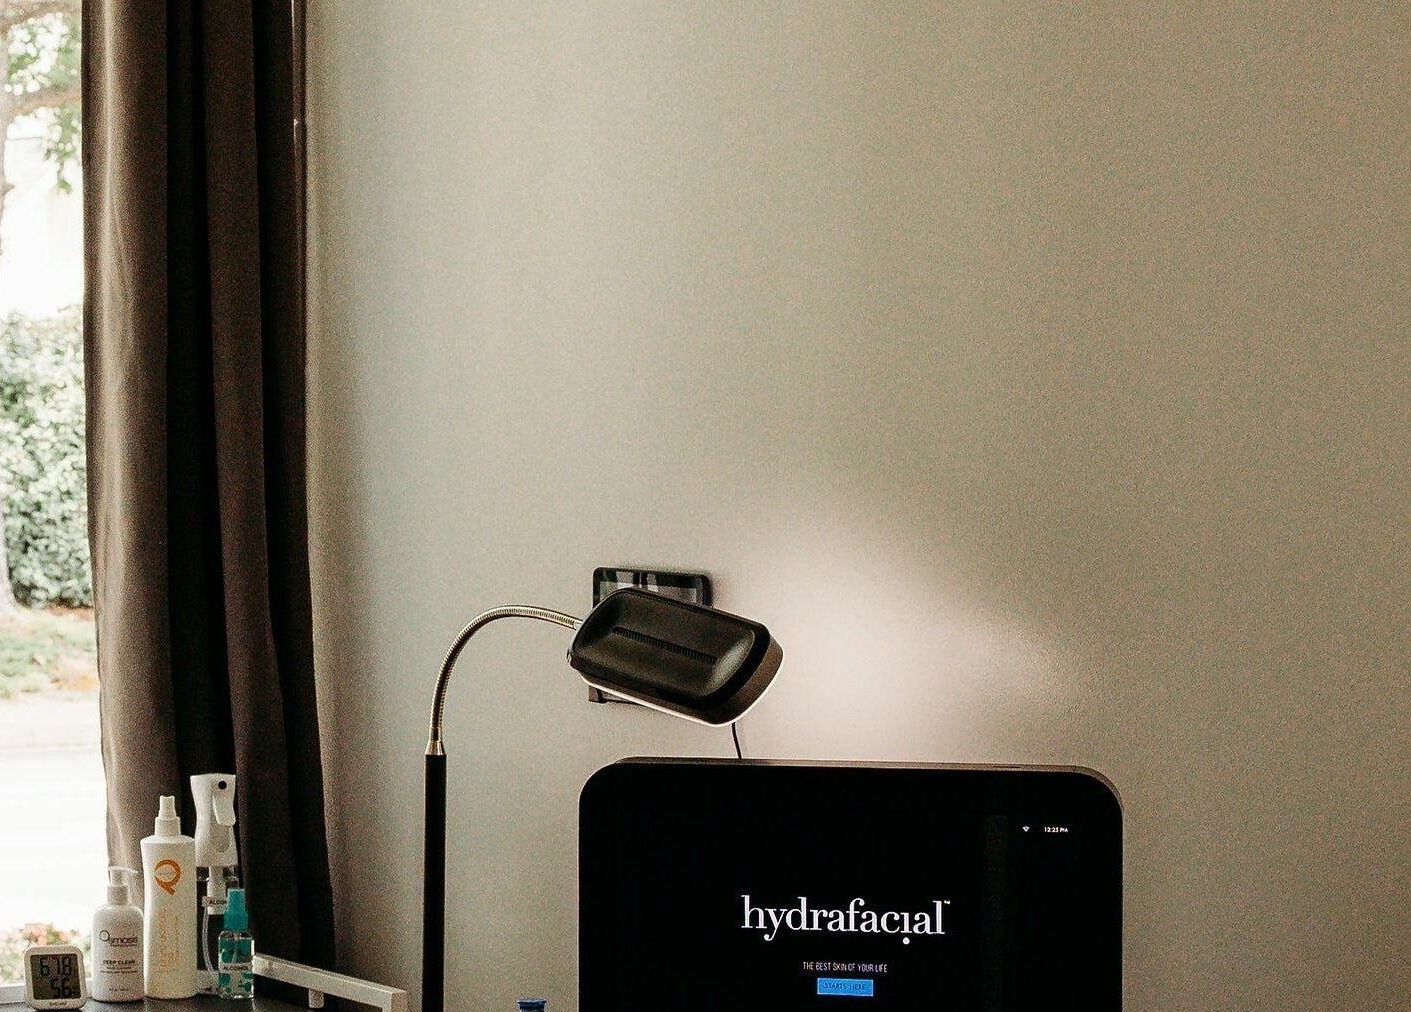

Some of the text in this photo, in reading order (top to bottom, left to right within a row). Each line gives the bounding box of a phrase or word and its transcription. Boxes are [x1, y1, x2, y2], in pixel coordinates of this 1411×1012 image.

[740, 894, 946, 945] hydrafacial
[802, 961, 888, 974] THE BEST SKIN OF YOUR LIFE
